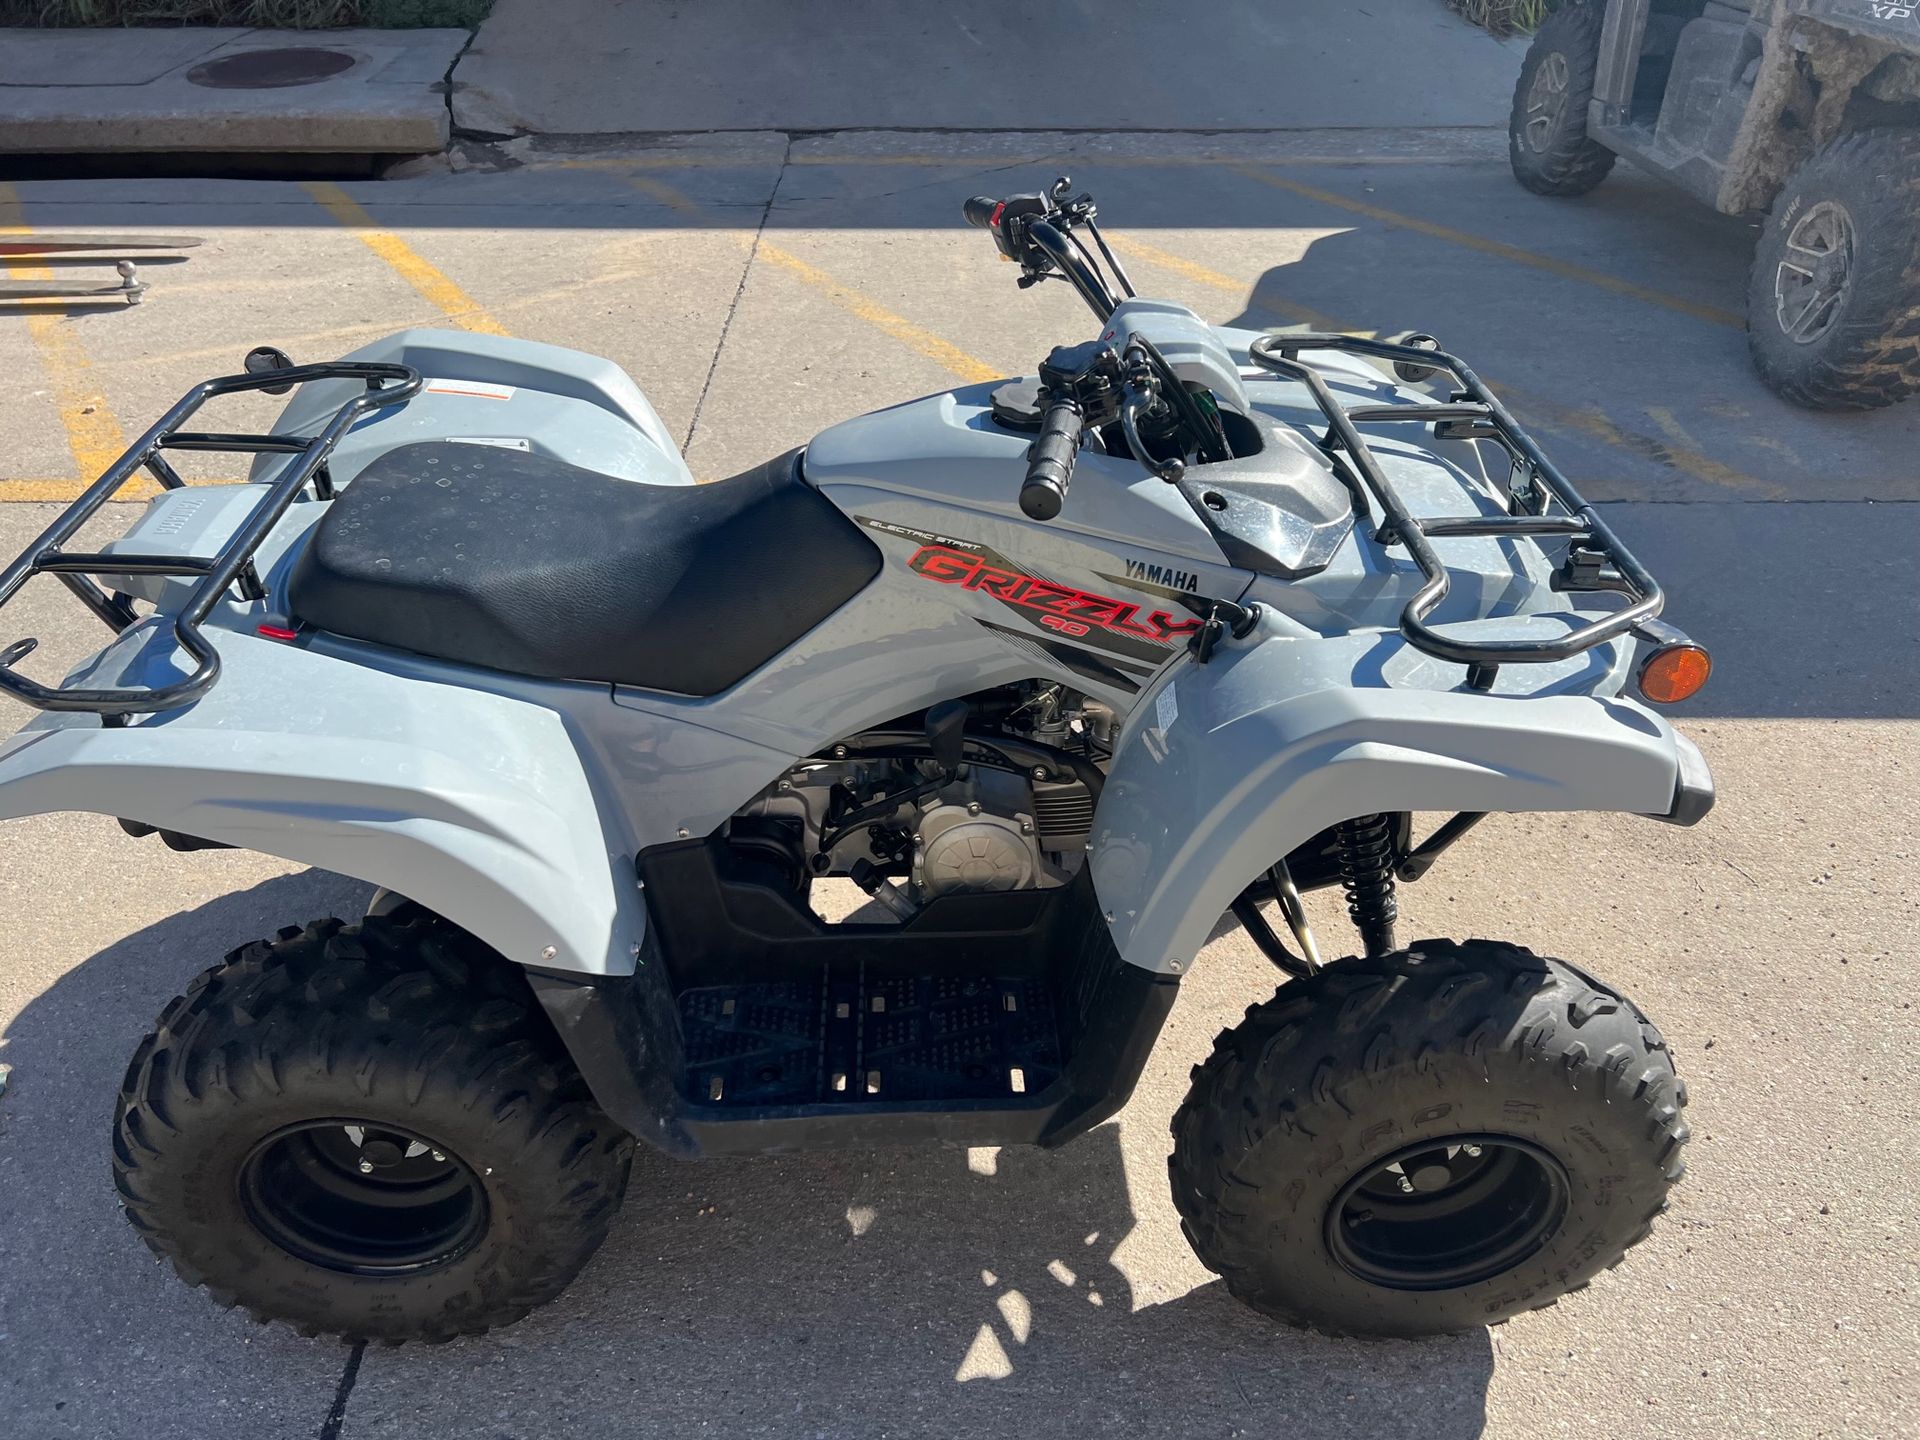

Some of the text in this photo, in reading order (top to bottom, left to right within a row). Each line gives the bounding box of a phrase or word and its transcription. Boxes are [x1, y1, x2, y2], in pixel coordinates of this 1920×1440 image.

[1872, 4, 1910, 20] XP
[869, 520, 981, 550] ELECTRIC START
[1125, 559, 1198, 593] YAMAHA
[907, 545, 1205, 642] GRIZZLY
[1039, 614, 1091, 637] 90
